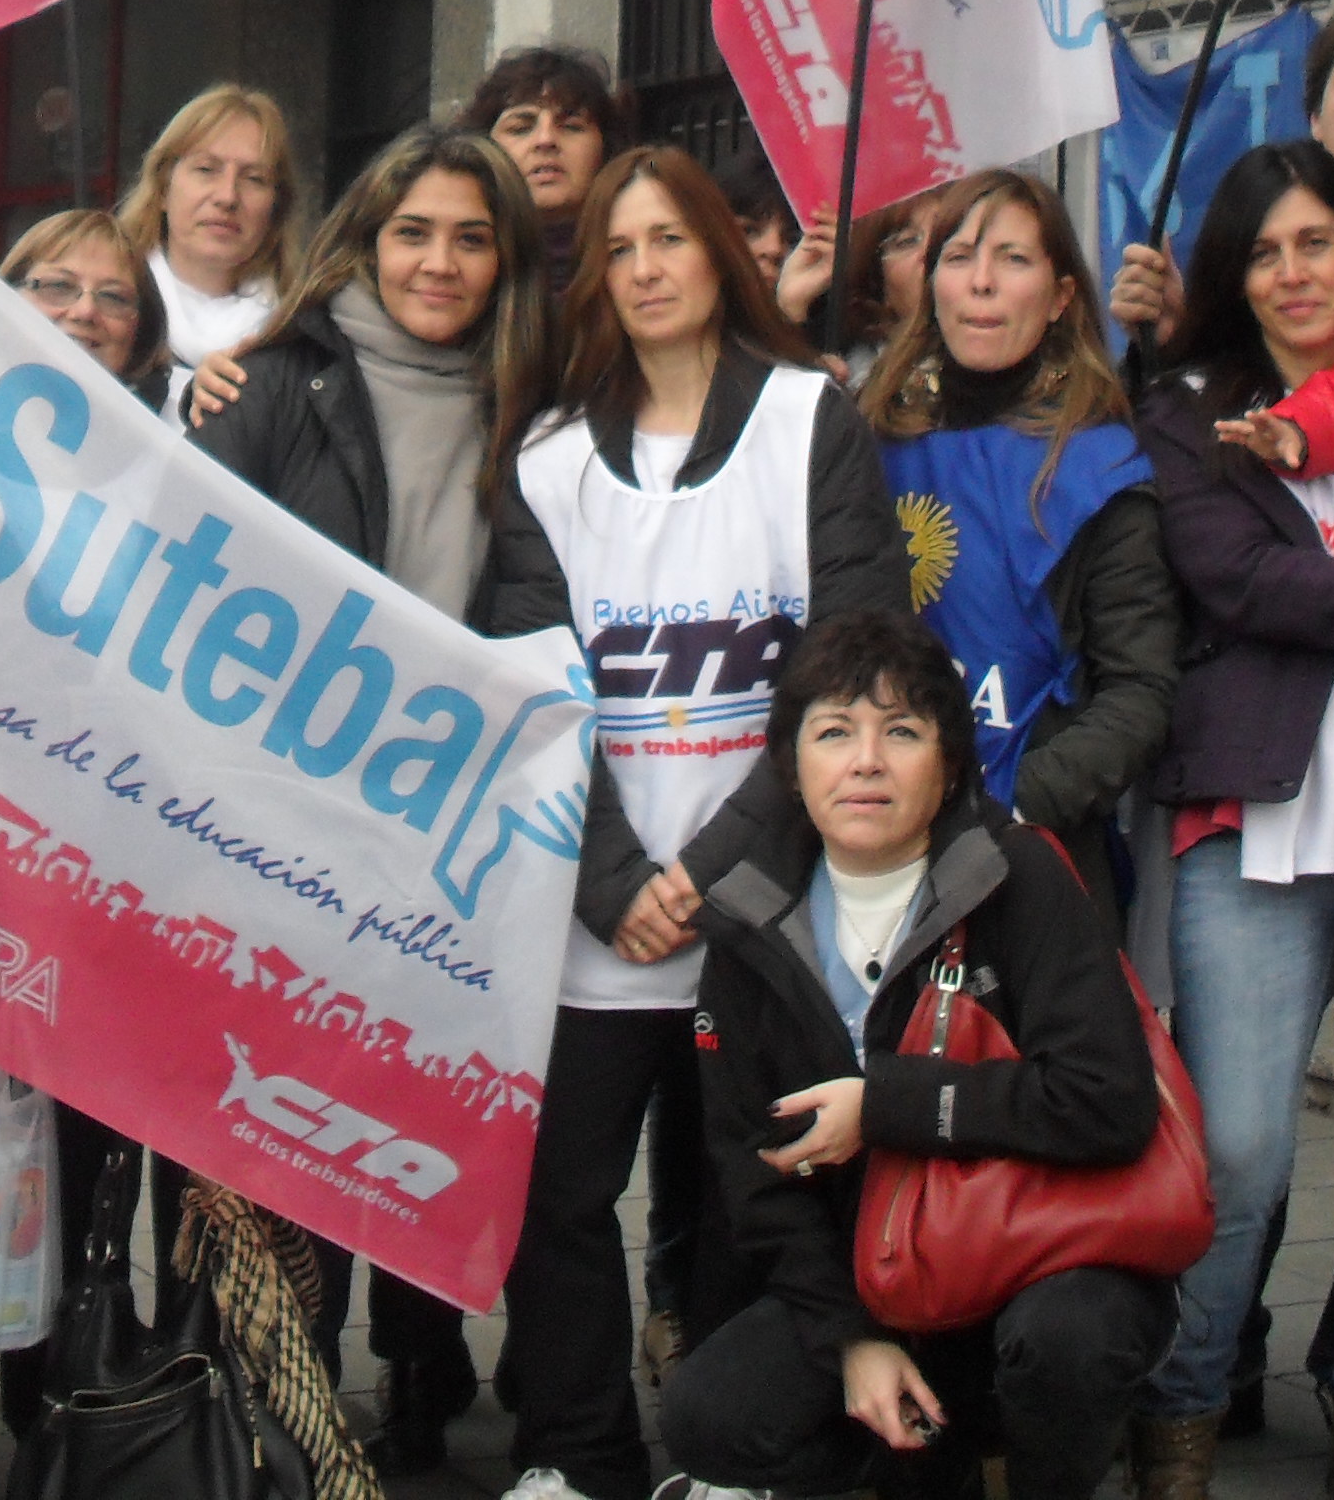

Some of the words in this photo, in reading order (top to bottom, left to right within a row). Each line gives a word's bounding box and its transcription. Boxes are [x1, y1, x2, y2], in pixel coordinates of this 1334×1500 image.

[593, 598, 710, 629] Buenos
[727, 588, 806, 622] Aires
[44, 728, 95, 773] de
[102, 753, 148, 804] la
[157, 797, 346, 914] educación
[346, 904, 494, 992] pública
[230, 1120, 258, 1145] de
[258, 1131, 289, 1162] los
[290, 1149, 423, 1225] trabajadores
[243, 1074, 462, 1201] CTA
